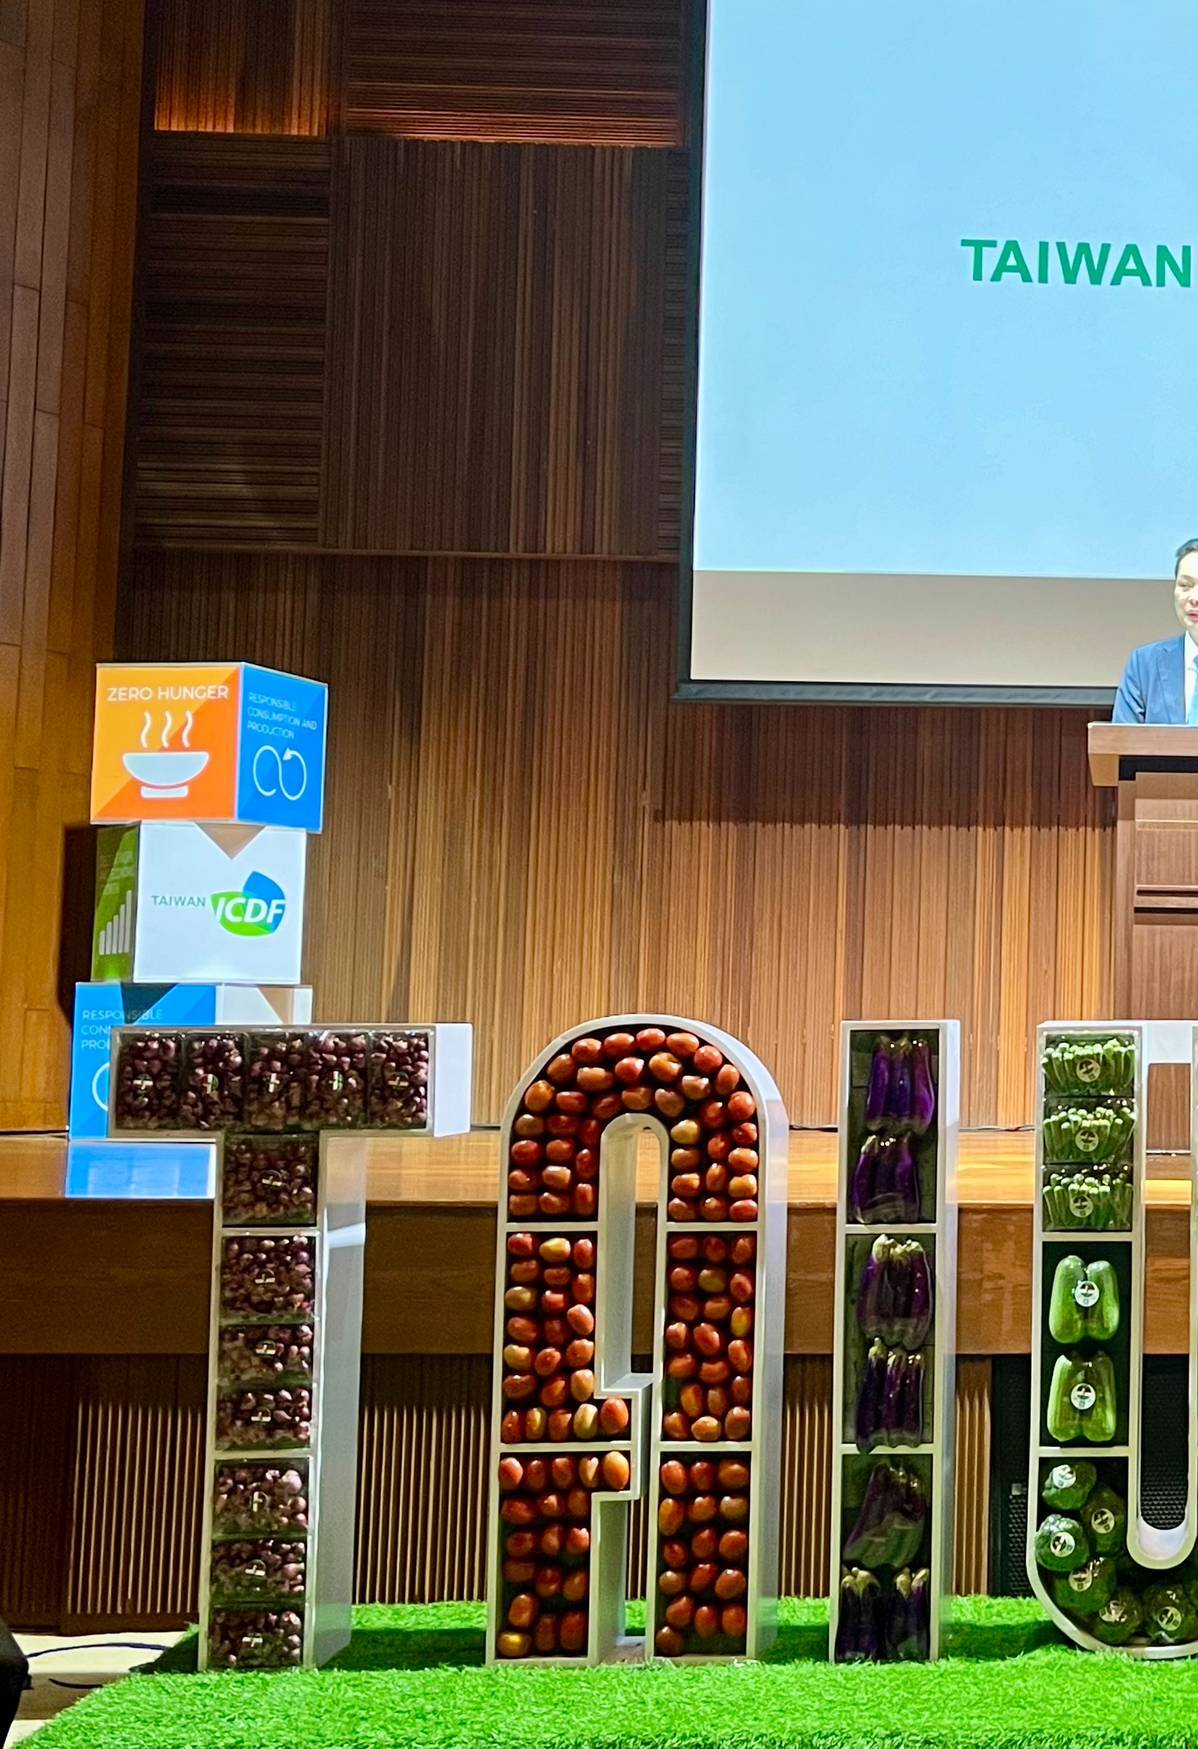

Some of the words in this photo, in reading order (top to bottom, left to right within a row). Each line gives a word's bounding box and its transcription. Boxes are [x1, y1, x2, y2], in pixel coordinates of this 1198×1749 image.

[960, 238, 1192, 288] TAIWAN
[107, 686, 152, 702] ZERO
[157, 685, 229, 700] HUNGER
[248, 692, 297, 712] RESPONSIBLE
[247, 707, 301, 726] CONSUMPTION
[302, 719, 318, 731] AND
[247, 723, 295, 739] PRODUCTION
[151, 895, 207, 908] TAIWAN
[214, 898, 286, 924] ICDF
[82, 1009, 163, 1021] RESPONSIBLE
